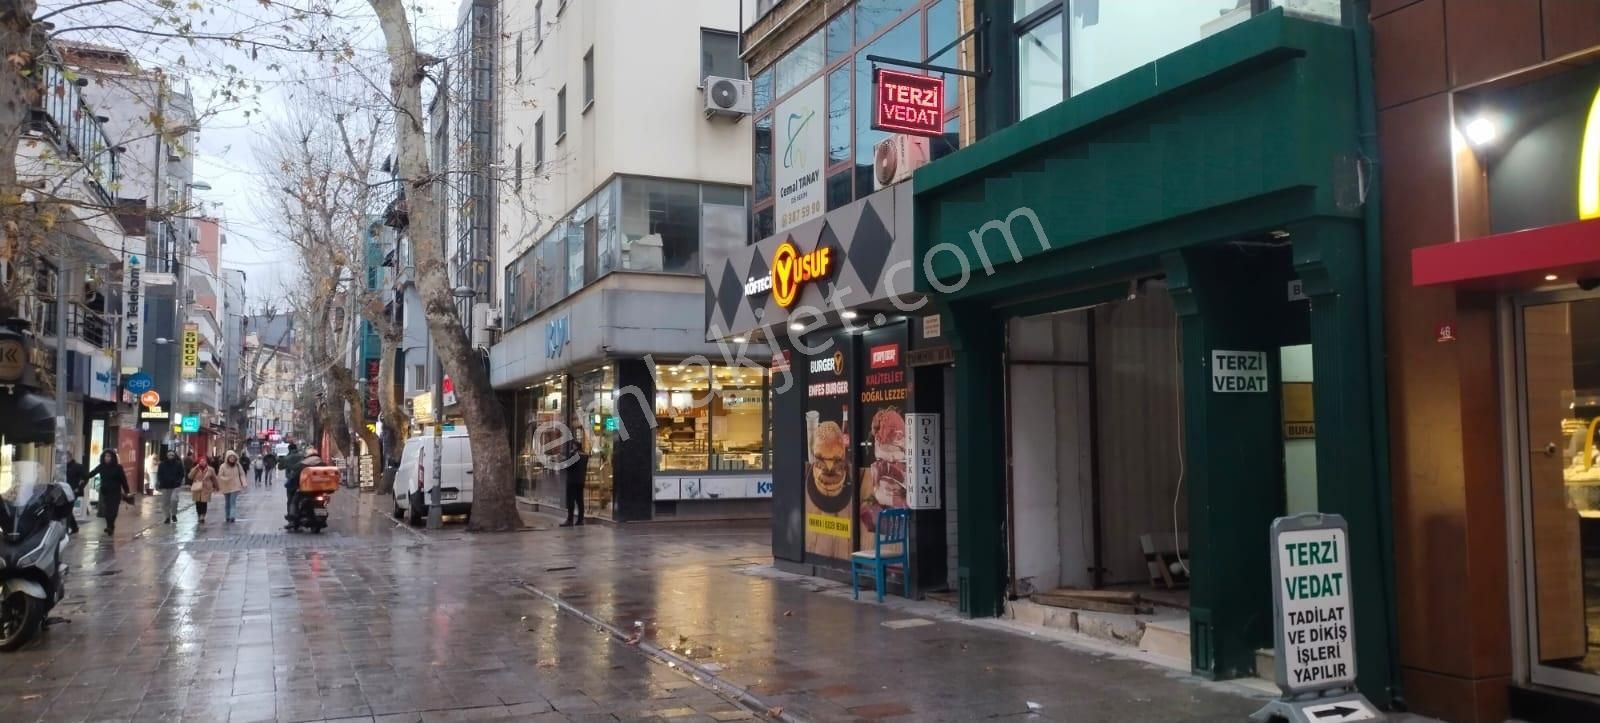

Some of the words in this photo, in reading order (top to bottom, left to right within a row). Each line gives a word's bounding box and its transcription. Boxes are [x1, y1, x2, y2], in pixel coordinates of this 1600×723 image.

[884, 83, 938, 107] TERZİ
[883, 103, 939, 126] VEDAT
[780, 179, 797, 198] Cemal
[799, 169, 820, 189] TANAY
[773, 245, 830, 305] YUSUF
[127, 267, 140, 320] Telekom
[126, 322, 139, 350] Türk
[810, 357, 835, 374] BURGER
[1216, 352, 1262, 370] TERZİ
[128, 379, 151, 390] cep
[825, 381, 849, 396] BURGER
[1214, 375, 1266, 391] VEDAT
[1285, 534, 1339, 567] TERZİ
[1285, 572, 1343, 600] VEDAT
[1288, 606, 1345, 626] TADİLAT
[1287, 629, 1310, 645] VE
[1310, 622, 1348, 643] DİKİŞ
[1296, 642, 1341, 666] İŞLERİ
[1293, 662, 1348, 683] YAPILIR
